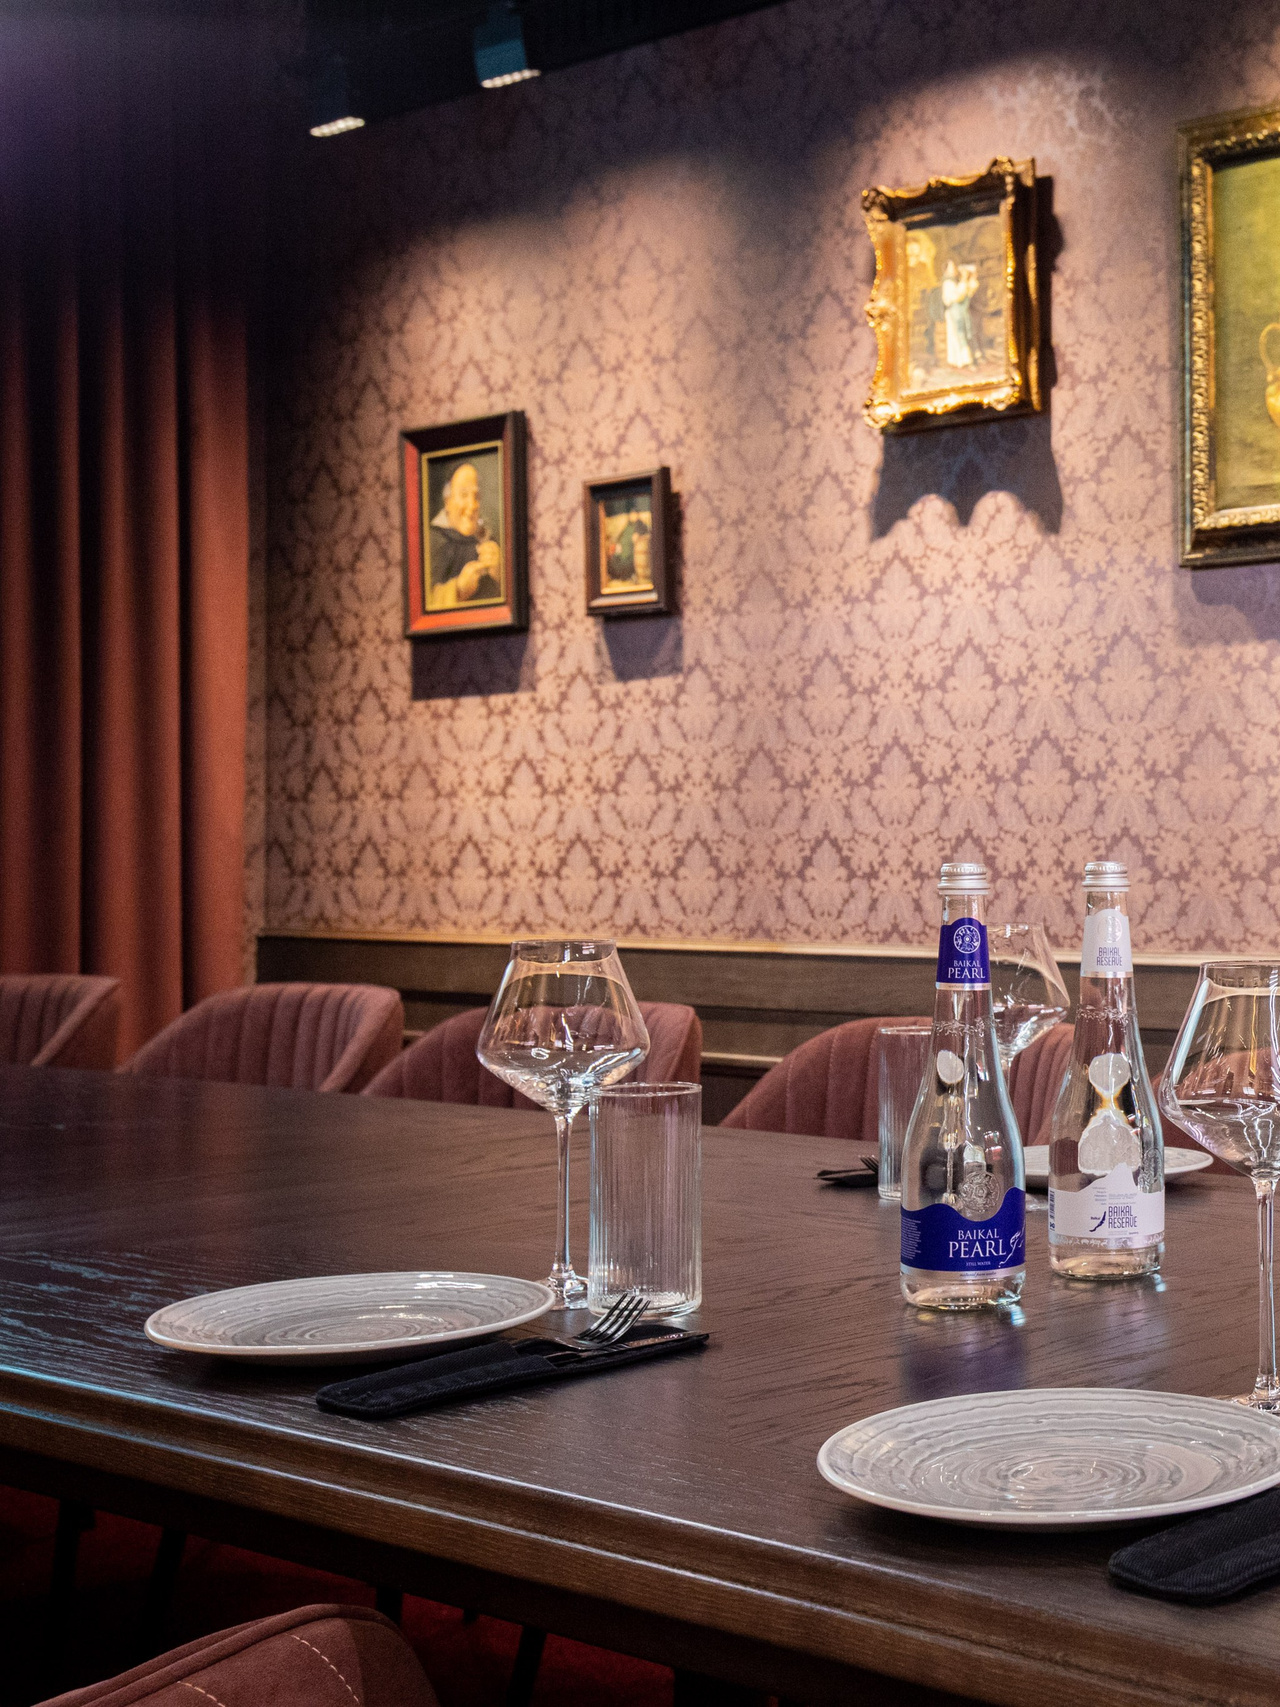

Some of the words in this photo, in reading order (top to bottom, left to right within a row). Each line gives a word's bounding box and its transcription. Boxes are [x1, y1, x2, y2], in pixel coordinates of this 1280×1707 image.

[1098, 947, 1120, 956] BAIKAL
[1096, 956, 1123, 966] RESERVE
[948, 968, 986, 979] PEARL
[1108, 1205, 1134, 1217] BAIKAL
[1108, 1216, 1138, 1229] RESERVE
[958, 1228, 1000, 1240] BAIKAL
[948, 1239, 1007, 1258] PEARL
